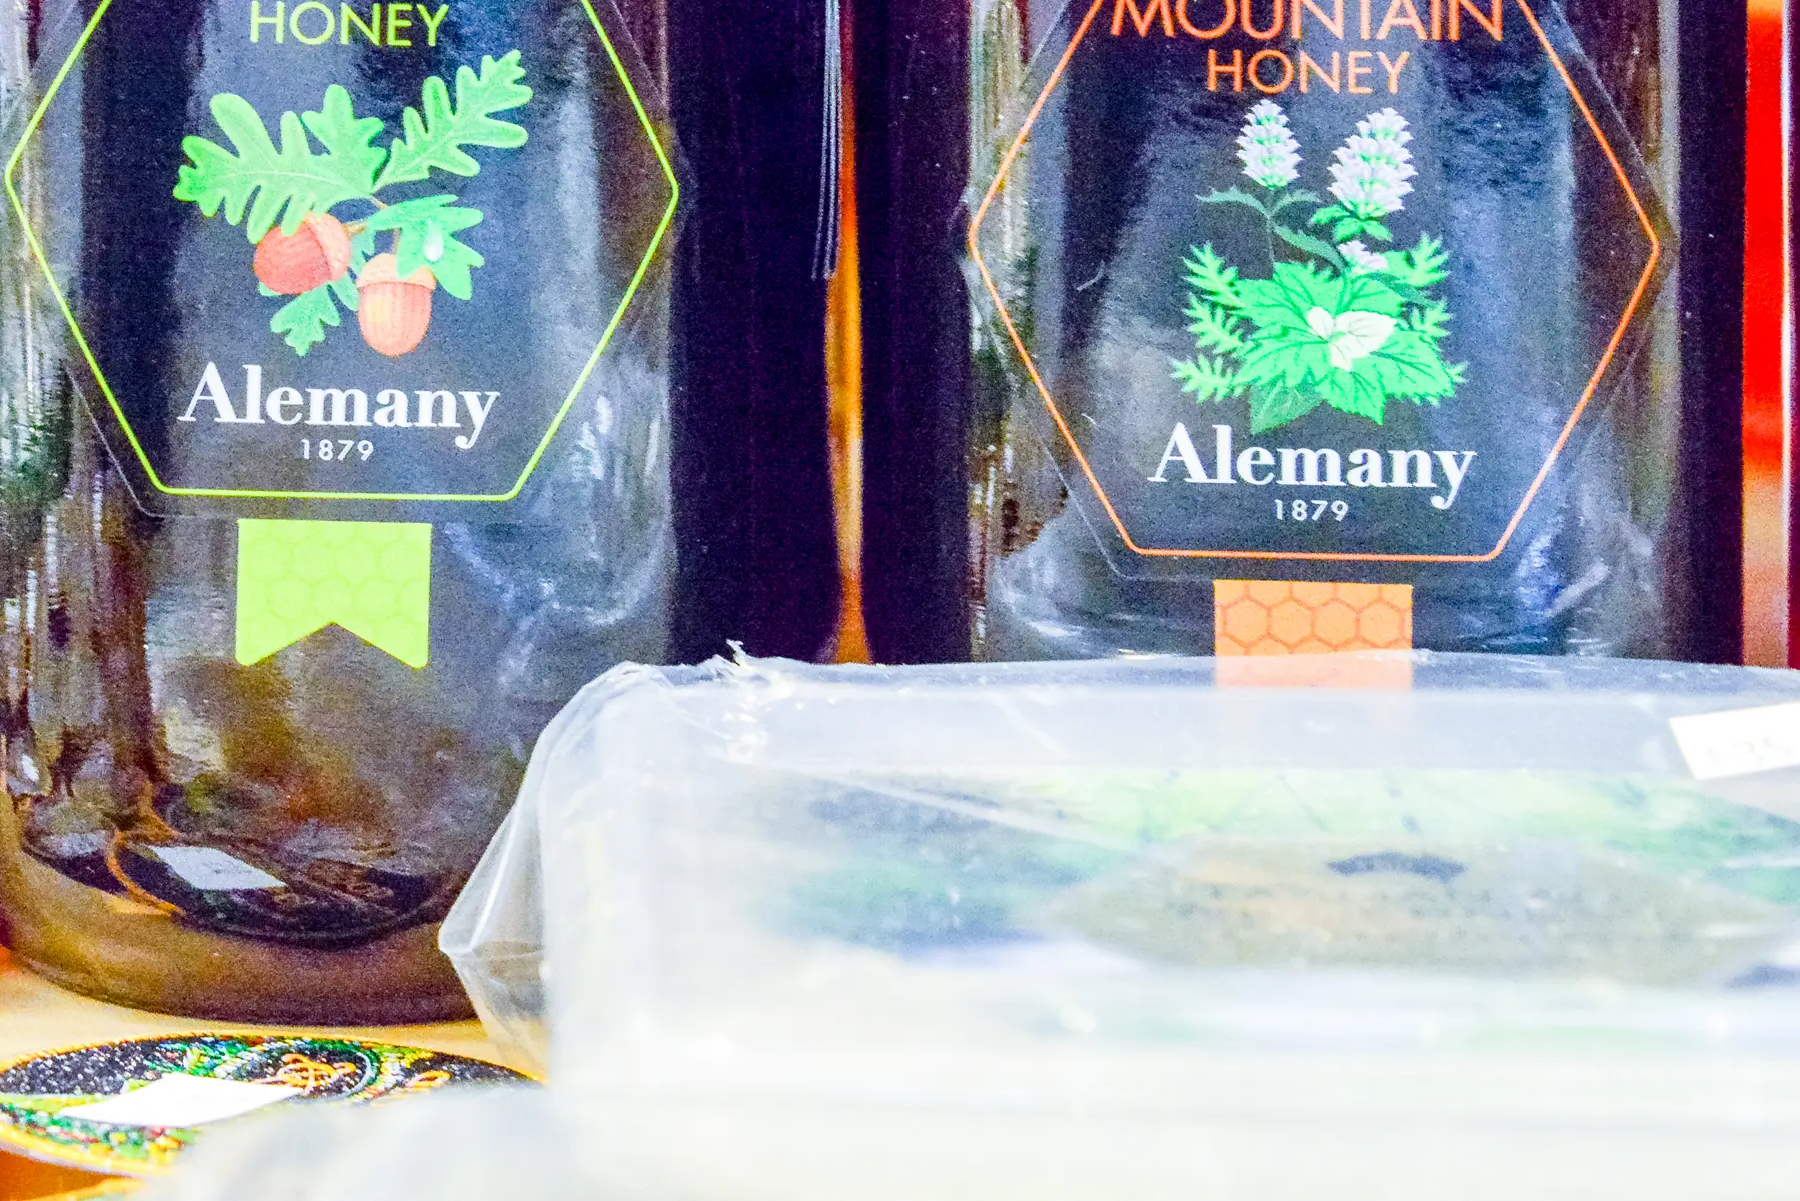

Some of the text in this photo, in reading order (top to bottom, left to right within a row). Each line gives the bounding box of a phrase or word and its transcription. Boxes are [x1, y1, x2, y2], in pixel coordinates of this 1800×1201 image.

[249, 0, 450, 47] HONEY
[1207, 48, 1410, 94] HONEY
[177, 360, 500, 450] Alemany
[300, 439, 374, 462] 1879
[1147, 421, 1478, 510] Alemany
[1274, 499, 1349, 522] 1879
